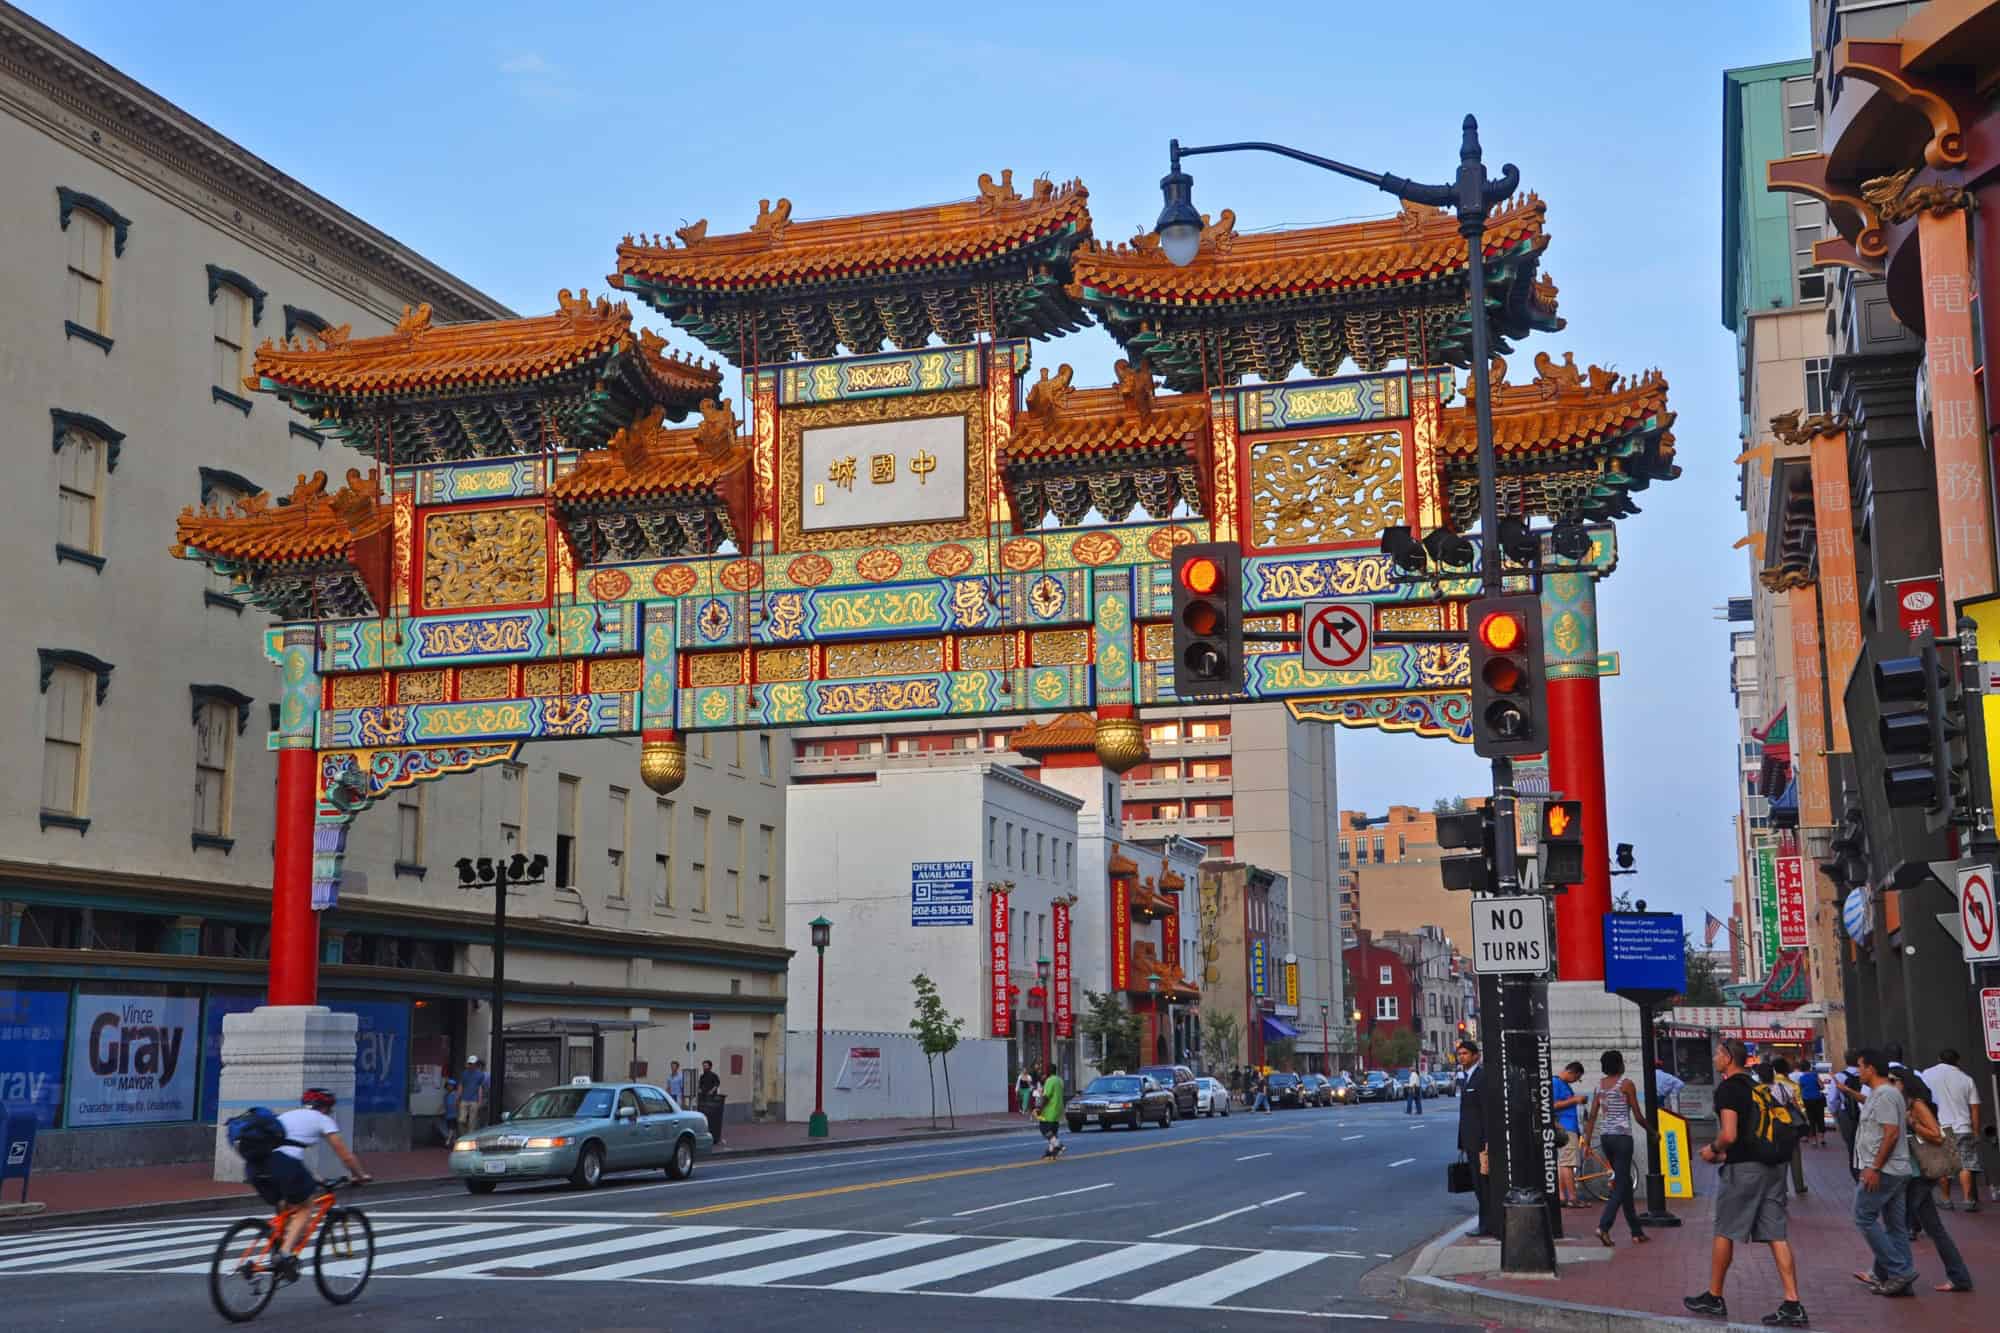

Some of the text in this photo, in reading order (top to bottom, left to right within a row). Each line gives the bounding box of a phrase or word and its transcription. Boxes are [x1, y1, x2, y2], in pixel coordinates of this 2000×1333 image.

[913, 862, 971, 871] OFFICE SPACE
[918, 871, 967, 879] AVAILABLE
[1779, 862, 1789, 922] TAISHAN
[1491, 908, 1524, 931] NO
[1482, 940, 1541, 961] TURNS
[122, 1003, 153, 1024] Vince
[1745, 1029, 1807, 1039] RESTAURANT
[89, 1012, 184, 1088] Gray
[0, 1071, 47, 1105] ray
[118, 1076, 154, 1091] MAYOR
[1541, 1128, 1556, 1194] Station
[1666, 1131, 1680, 1176] express
